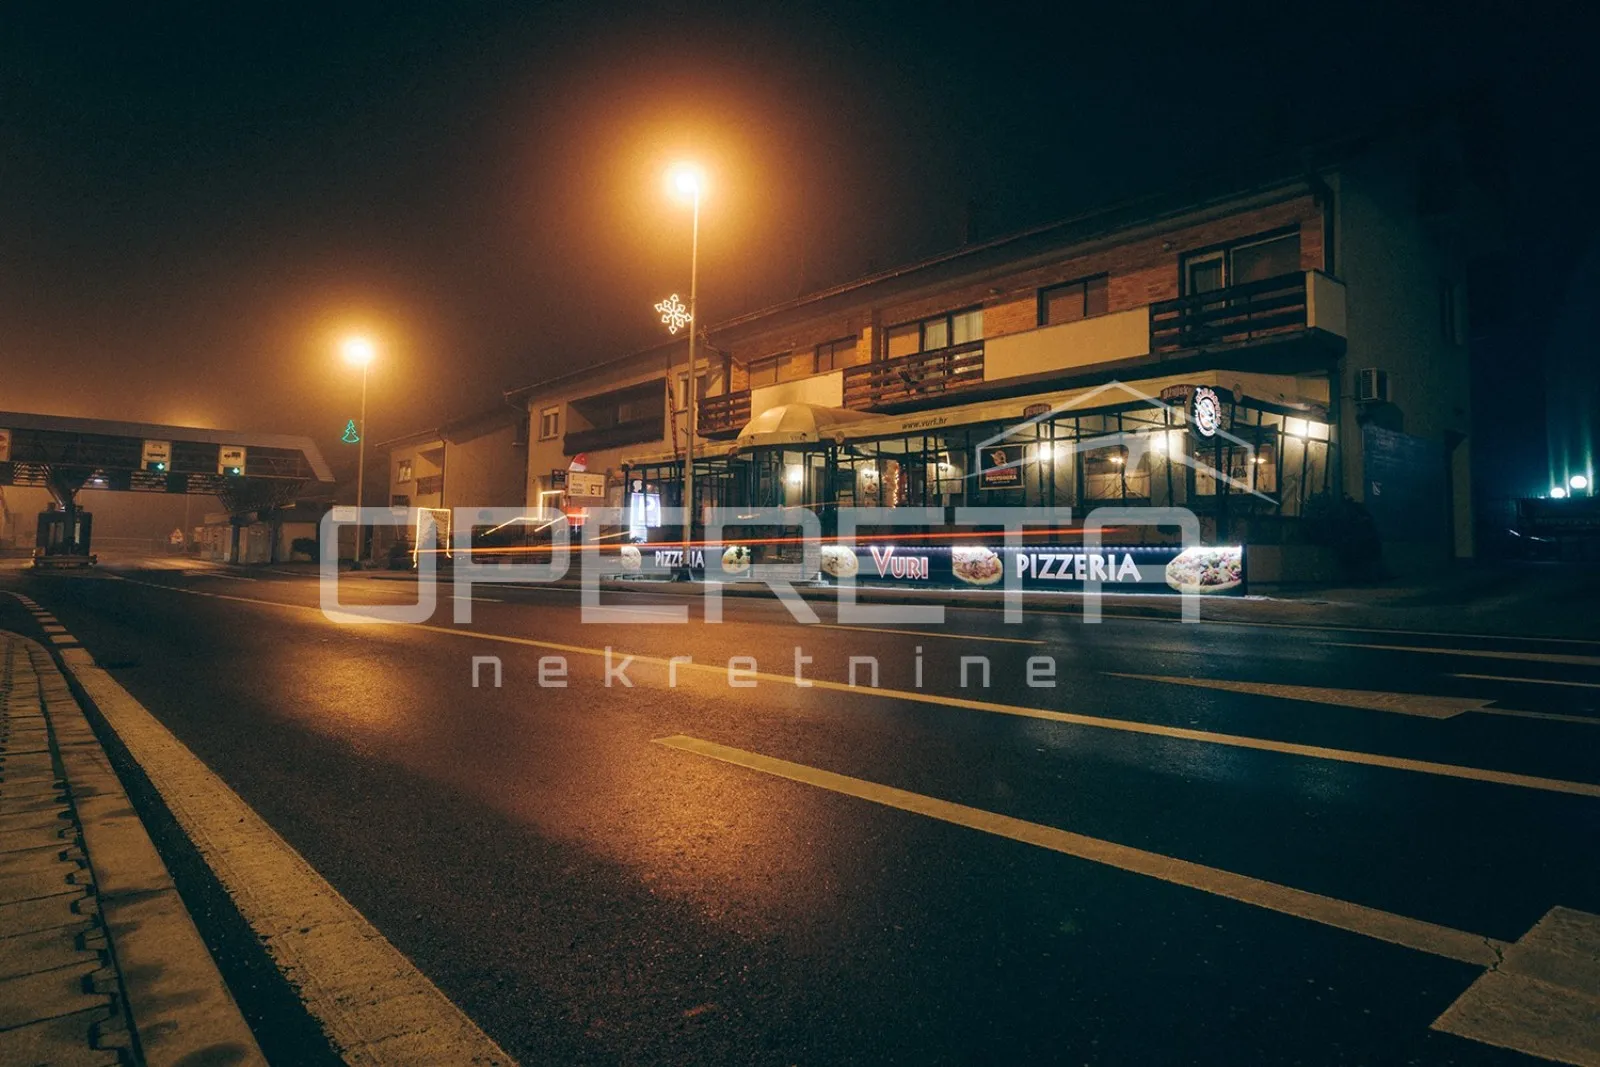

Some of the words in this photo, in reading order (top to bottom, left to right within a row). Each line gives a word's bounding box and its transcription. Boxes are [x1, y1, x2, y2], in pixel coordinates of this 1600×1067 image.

[901, 416, 949, 430] www.vuri.hr
[654, 550, 705, 569] PIZZEIA
[1015, 552, 1142, 583] PIZZERIA
